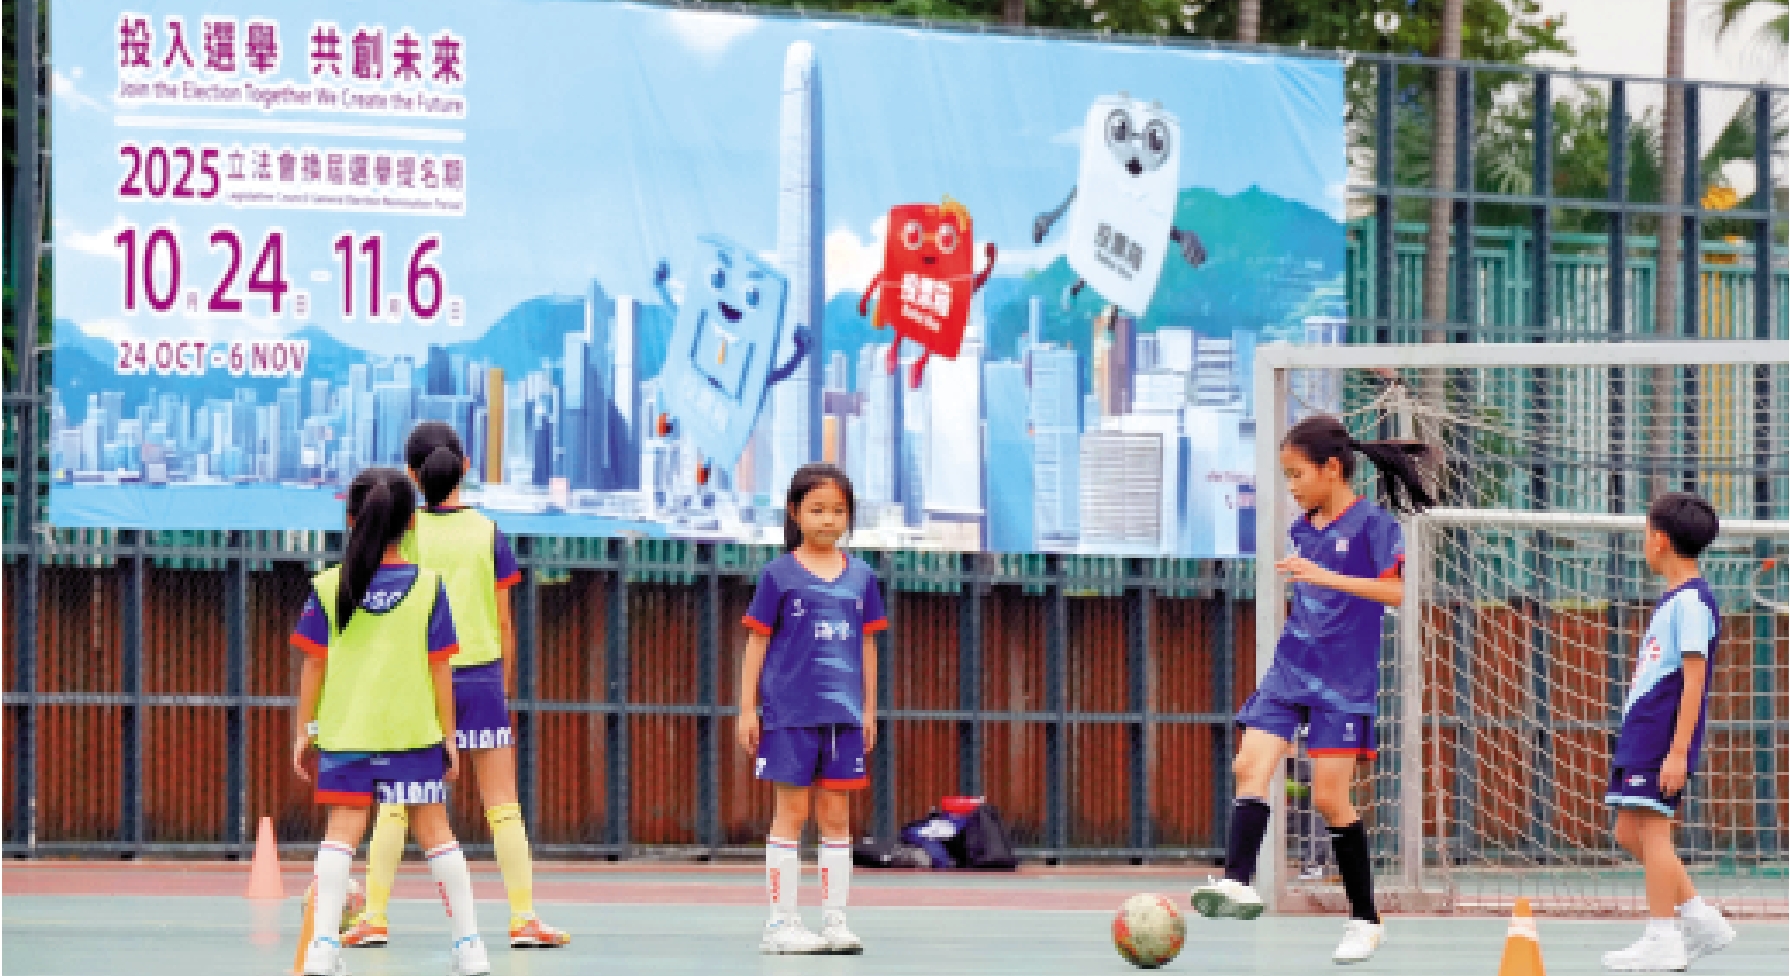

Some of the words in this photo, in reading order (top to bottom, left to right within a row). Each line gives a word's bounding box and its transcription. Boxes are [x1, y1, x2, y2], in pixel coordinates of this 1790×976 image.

[119, 14, 278, 74] 投入選舉
[310, 24, 462, 84] 共創未來
[119, 79, 150, 99] Join
[152, 80, 178, 99] the
[182, 80, 242, 101] Election
[245, 82, 312, 110] Together
[314, 86, 337, 105] We
[342, 88, 388, 110] Create
[390, 90, 413, 111] the
[417, 91, 464, 113] Future
[118, 146, 221, 199] 2025
[119, 341, 147, 370] 24
[156, 341, 207, 370] OCT
[229, 342, 244, 372] 6
[250, 342, 306, 372] NOV
